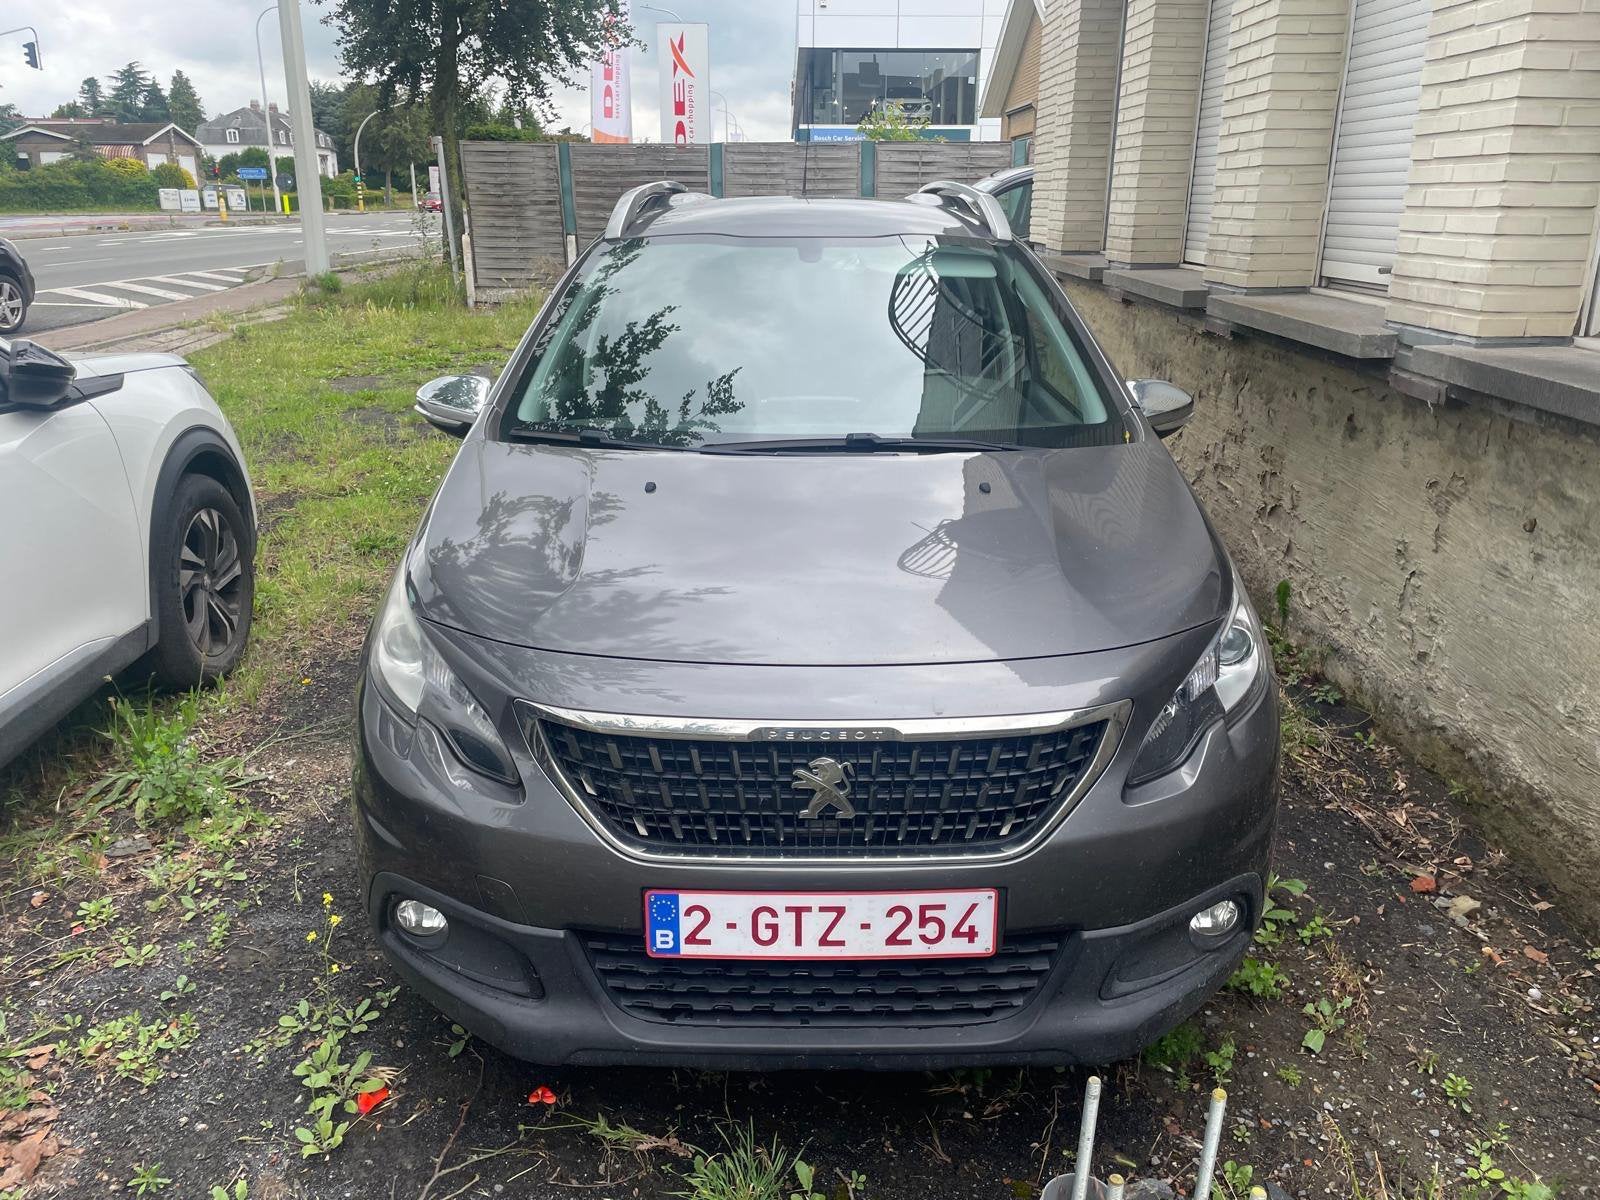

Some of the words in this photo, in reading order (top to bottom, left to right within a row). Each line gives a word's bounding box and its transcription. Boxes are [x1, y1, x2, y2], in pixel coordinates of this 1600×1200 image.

[768, 731, 883, 740] PEUGEOT
[684, 903, 979, 947] 2-GTZ-254
[656, 930, 674, 948] B
